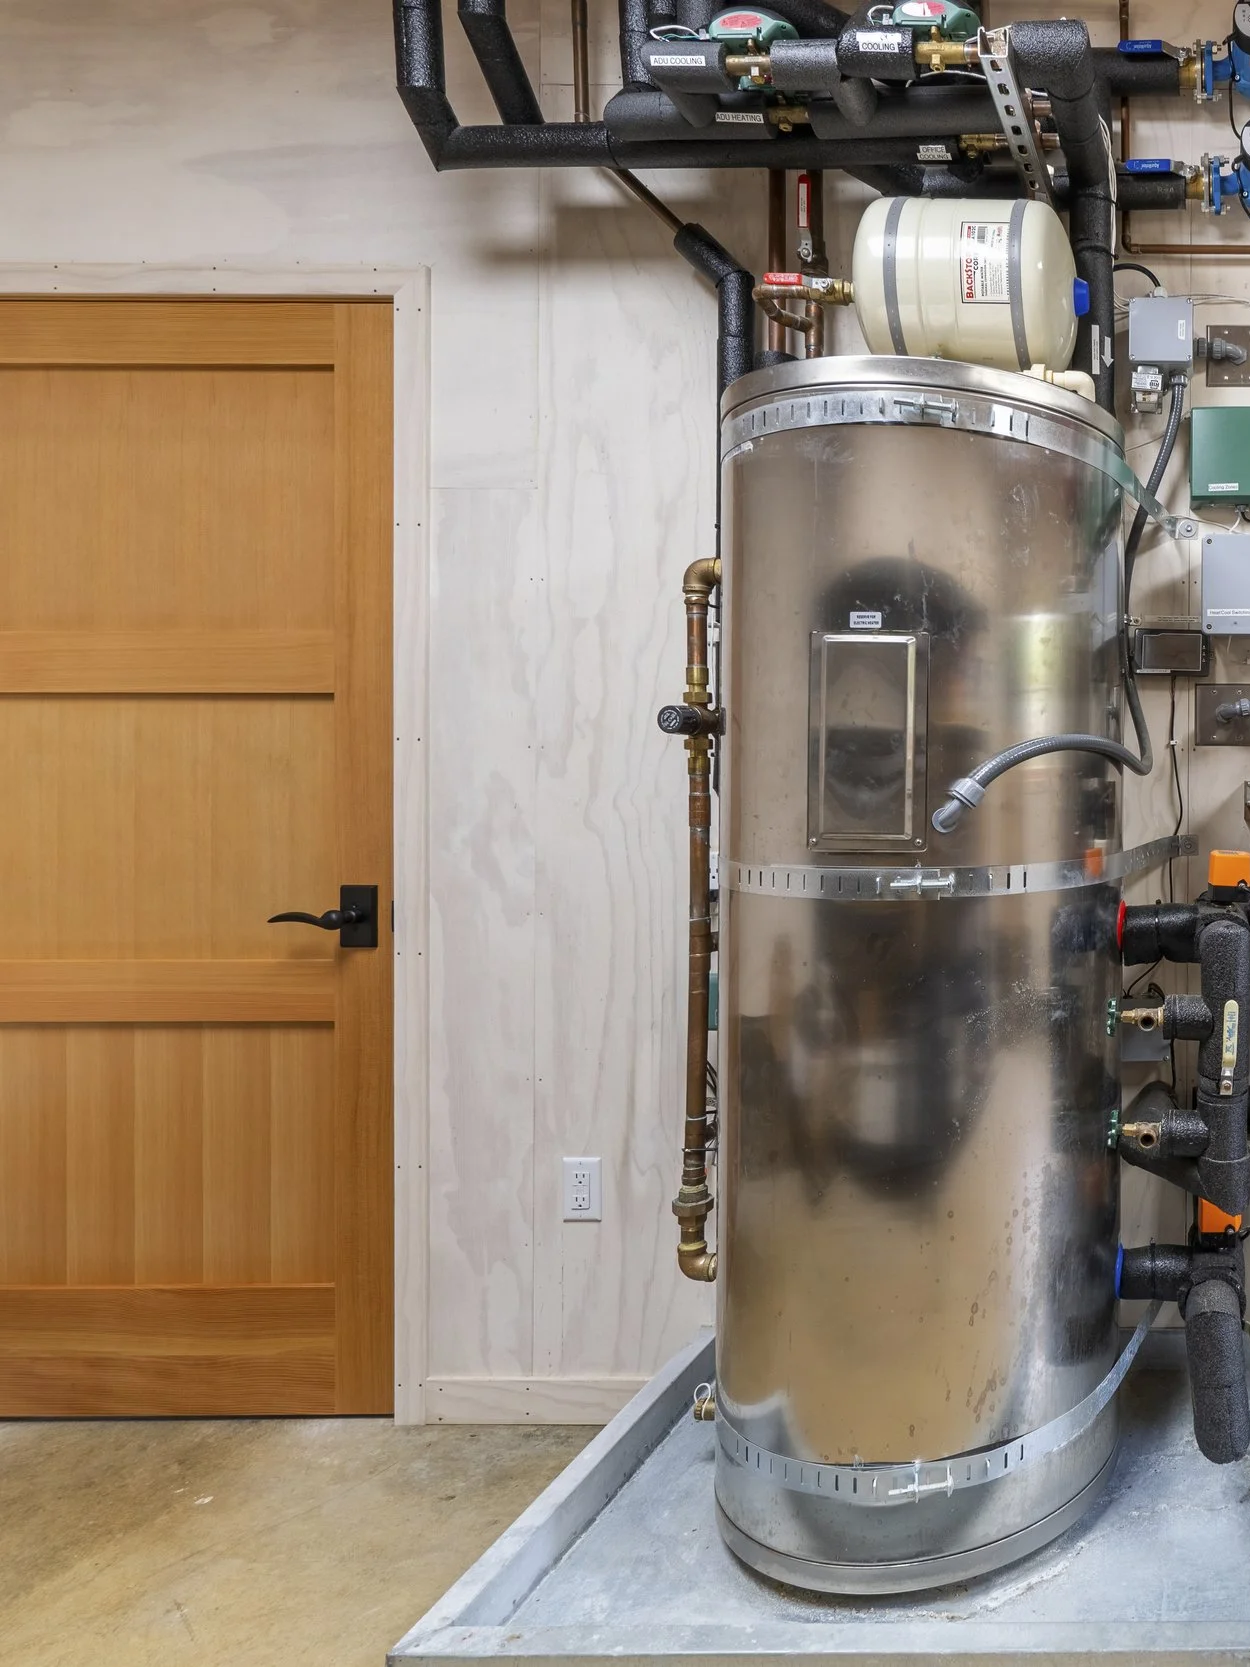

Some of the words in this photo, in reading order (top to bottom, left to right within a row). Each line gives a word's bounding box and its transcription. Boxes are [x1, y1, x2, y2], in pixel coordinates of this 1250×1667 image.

[862, 42, 896, 51] COOLING
[653, 57, 669, 65] ADU
[670, 57, 703, 65] COOLING
[716, 113, 731, 121] ADU
[732, 114, 762, 122] HEATING
